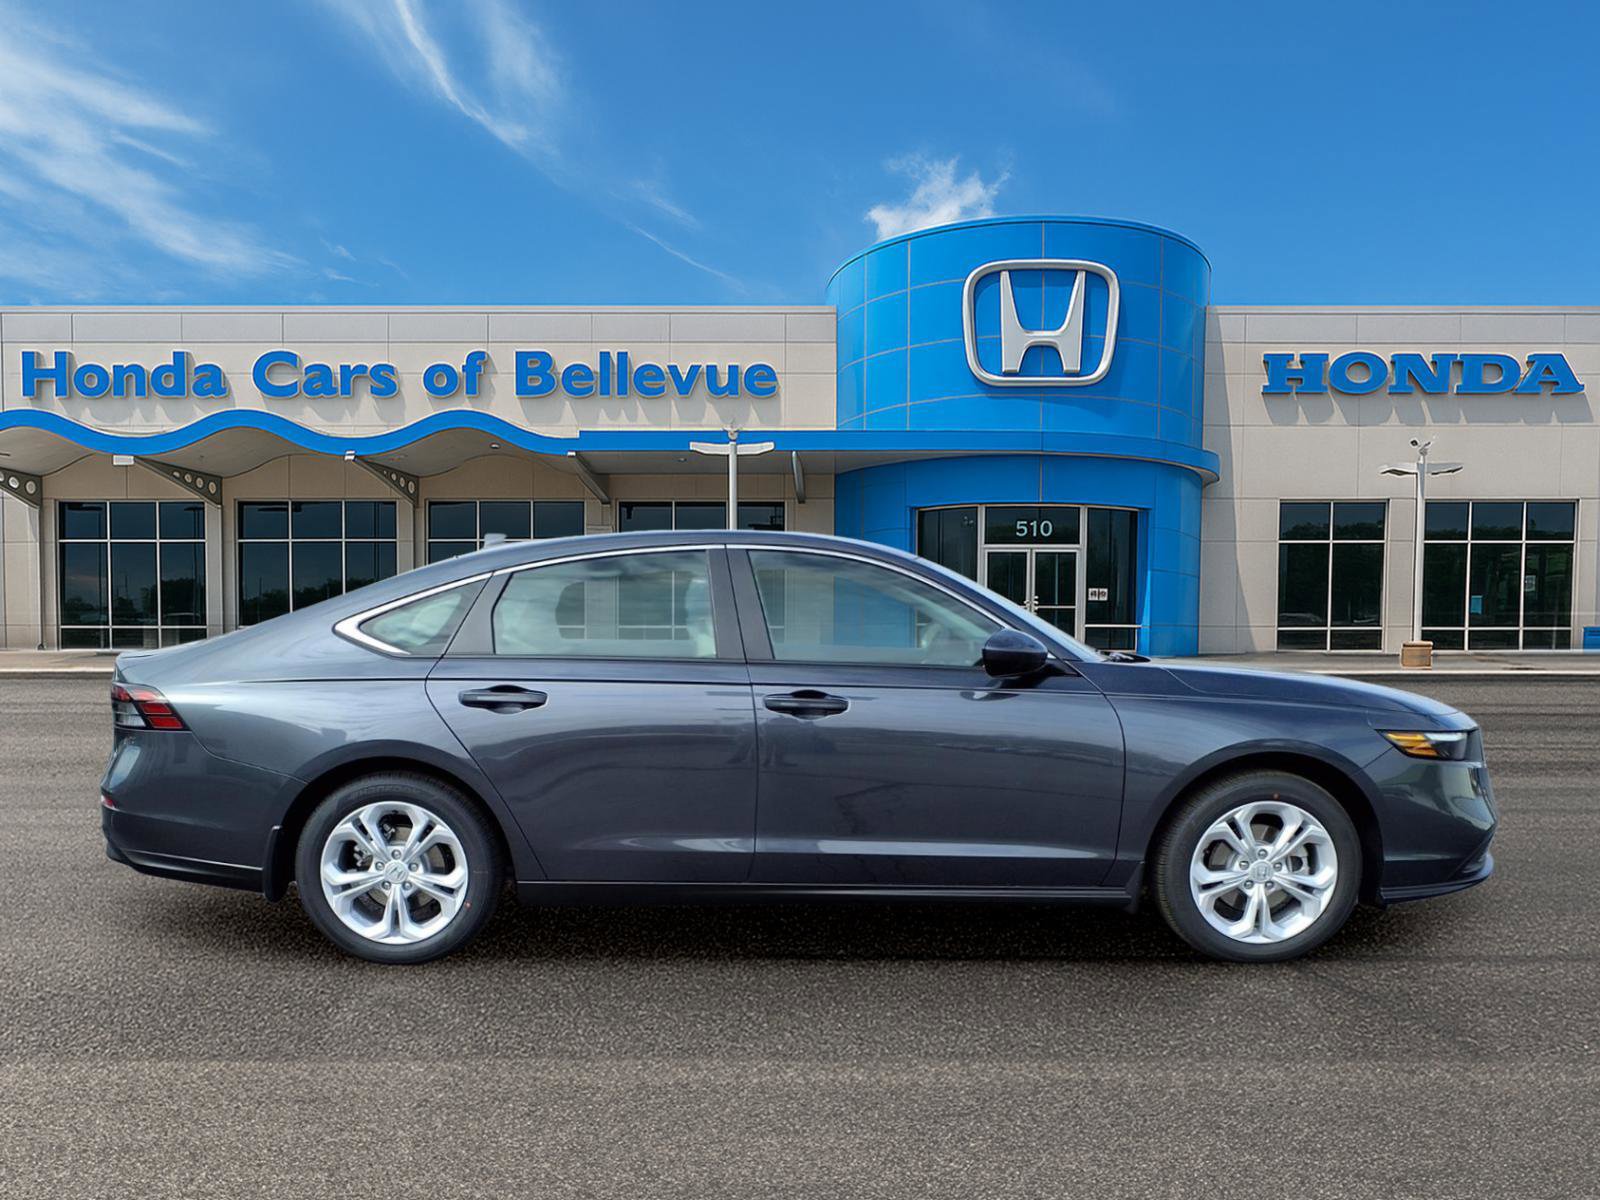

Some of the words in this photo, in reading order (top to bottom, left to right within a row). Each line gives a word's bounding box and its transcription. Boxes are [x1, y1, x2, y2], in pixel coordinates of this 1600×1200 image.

[20, 350, 229, 399] Honda
[252, 349, 399, 399] Cars
[422, 350, 488, 398] of
[514, 350, 779, 398] Bellevue
[1262, 351, 1585, 395] HONDA
[1015, 520, 1053, 537] 510
